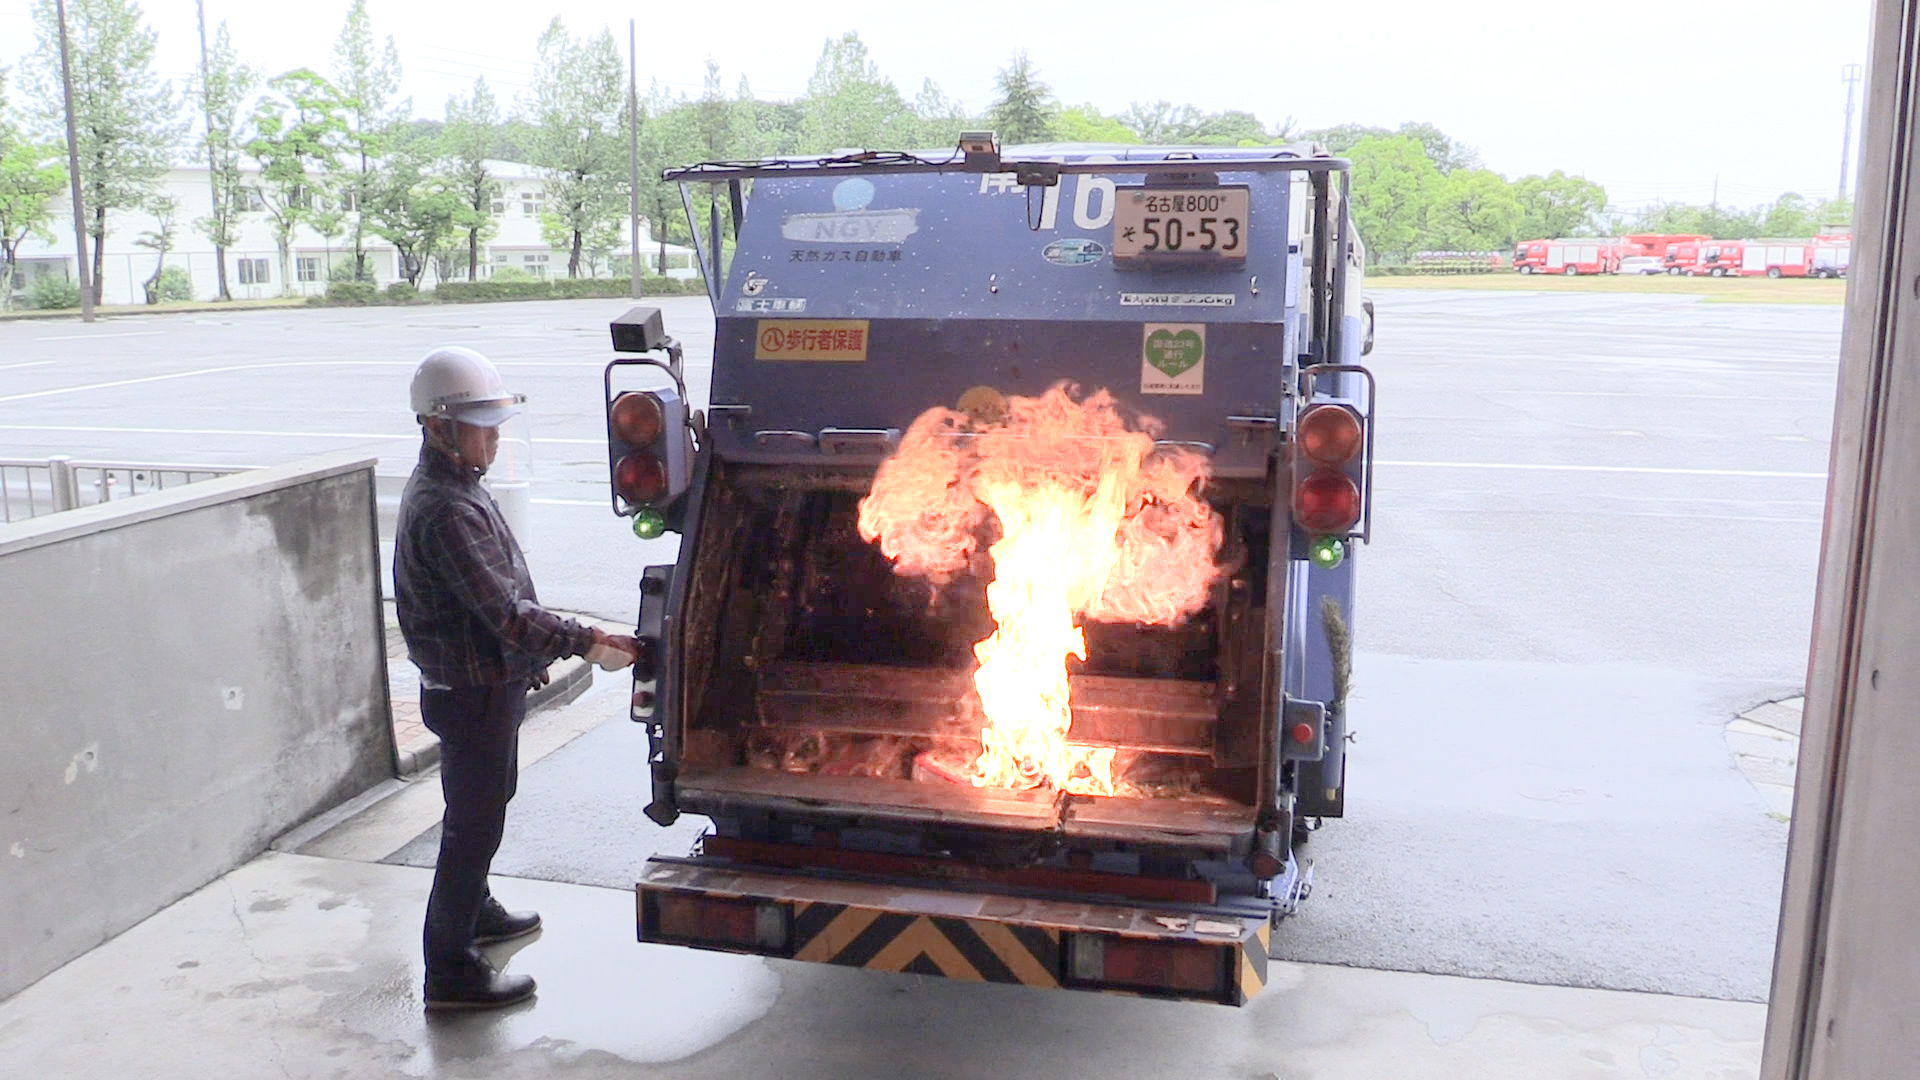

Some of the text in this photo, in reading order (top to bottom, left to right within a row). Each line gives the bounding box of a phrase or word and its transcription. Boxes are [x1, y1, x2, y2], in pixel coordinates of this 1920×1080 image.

[1039, 156, 1116, 230] 16
[1145, 195, 1219, 213] 名古屋800
[815, 218, 884, 239] NGV
[1122, 217, 1240, 251] そ 50-53
[789, 249, 902, 262] 天然ガス自動車
